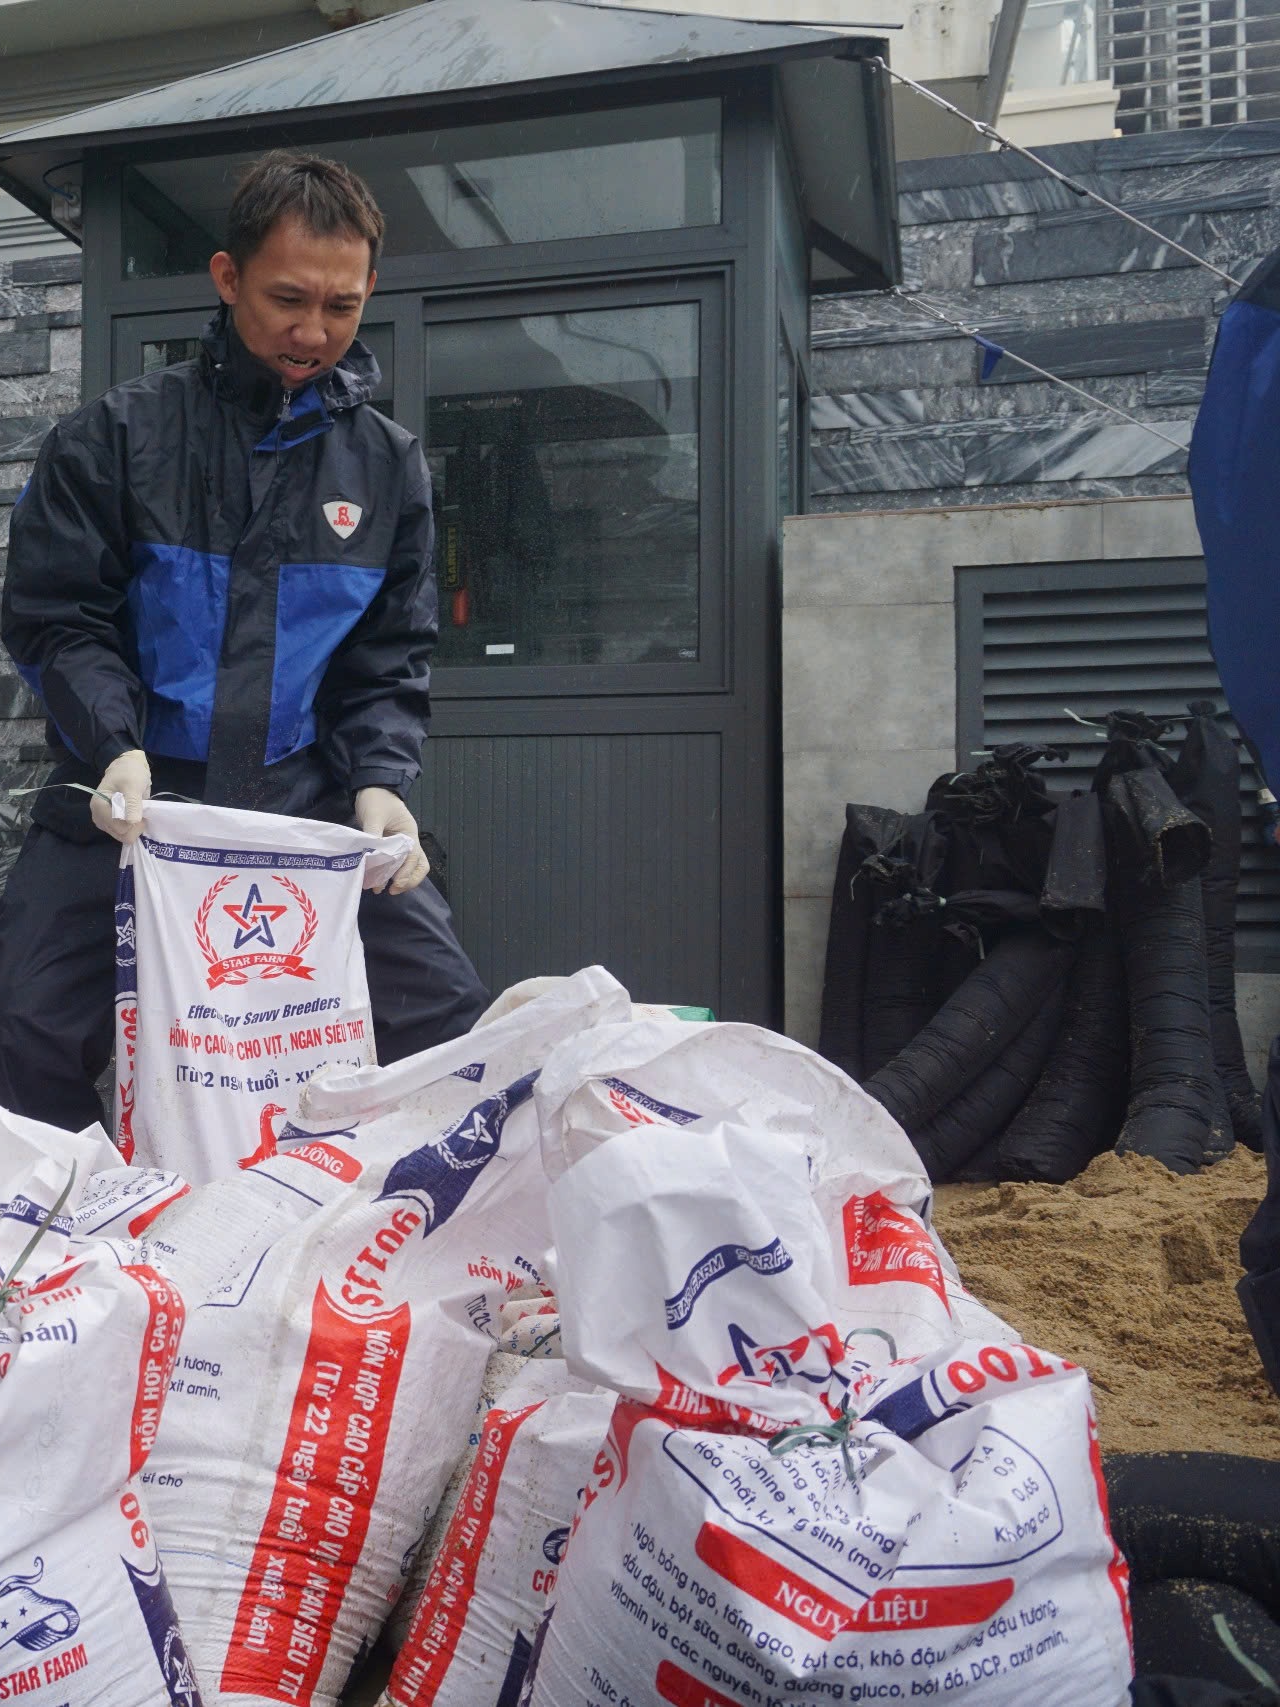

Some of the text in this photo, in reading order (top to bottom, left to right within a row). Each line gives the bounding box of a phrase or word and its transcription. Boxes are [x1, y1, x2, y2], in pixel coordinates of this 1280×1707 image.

[222, 955, 288, 970] STAR FARM
[242, 1008, 279, 1026] Savvy
[282, 996, 341, 1019] Breeders
[236, 1039, 261, 1061] CHO
[264, 1034, 288, 1060] VỊT,
[289, 1027, 323, 1051] NGAN
[324, 1018, 348, 1045] SIÊU
[247, 1069, 280, 1093] tuổi
[152, 1240, 178, 1255] max
[340, 1207, 423, 1308] 9011S
[466, 1255, 503, 1285] HỖN
[183, 1355, 224, 1377] tương,
[360, 1328, 400, 1370] HỖN
[134, 1406, 156, 1452] HỖN
[149, 1312, 168, 1353] CAO
[186, 1383, 222, 1401] amin,
[347, 1369, 382, 1412] HỢP
[302, 1402, 332, 1437] 22
[343, 1412, 373, 1454] CAO
[286, 1440, 319, 1492] ngày
[477, 1426, 504, 1470] CẤP
[993, 1456, 1017, 1477] 0,9
[158, 1473, 184, 1488] cho
[335, 1454, 370, 1497] CẤP
[471, 1470, 490, 1514] CHO
[1011, 1476, 1040, 1502] 0,65
[276, 1496, 311, 1544] tuổi
[324, 1496, 356, 1538] CHO
[722, 1467, 758, 1512] chất,
[810, 1525, 845, 1553] sinh
[657, 1548, 689, 1589] bỏng
[690, 1579, 719, 1615] ngô,
[723, 1604, 755, 1637] tấm
[754, 1630, 796, 1664] gạo,
[833, 1649, 864, 1670] cá,
[870, 1650, 905, 1666] khô
[987, 1616, 1018, 1638] đậu
[773, 1580, 929, 1634] NGUY LIỆU
[610, 1579, 649, 1625] vitamin
[650, 1619, 670, 1641] và
[670, 1634, 701, 1664] các
[701, 1657, 768, 1704] nguyên
[641, 1573, 667, 1608] đậu,
[669, 1595, 693, 1625] bột
[693, 1618, 722, 1650] sữa,
[726, 1639, 780, 1688] đường,
[784, 1679, 845, 1700] đường
[849, 1682, 905, 1701] gluco,
[910, 1676, 939, 1698] bột
[943, 1669, 969, 1691] đá,
[970, 1654, 1008, 1682] DCP,
[1009, 1644, 1034, 1668] axit
[1035, 1629, 1070, 1657] amin,
[42, 1642, 89, 1685] FARM
